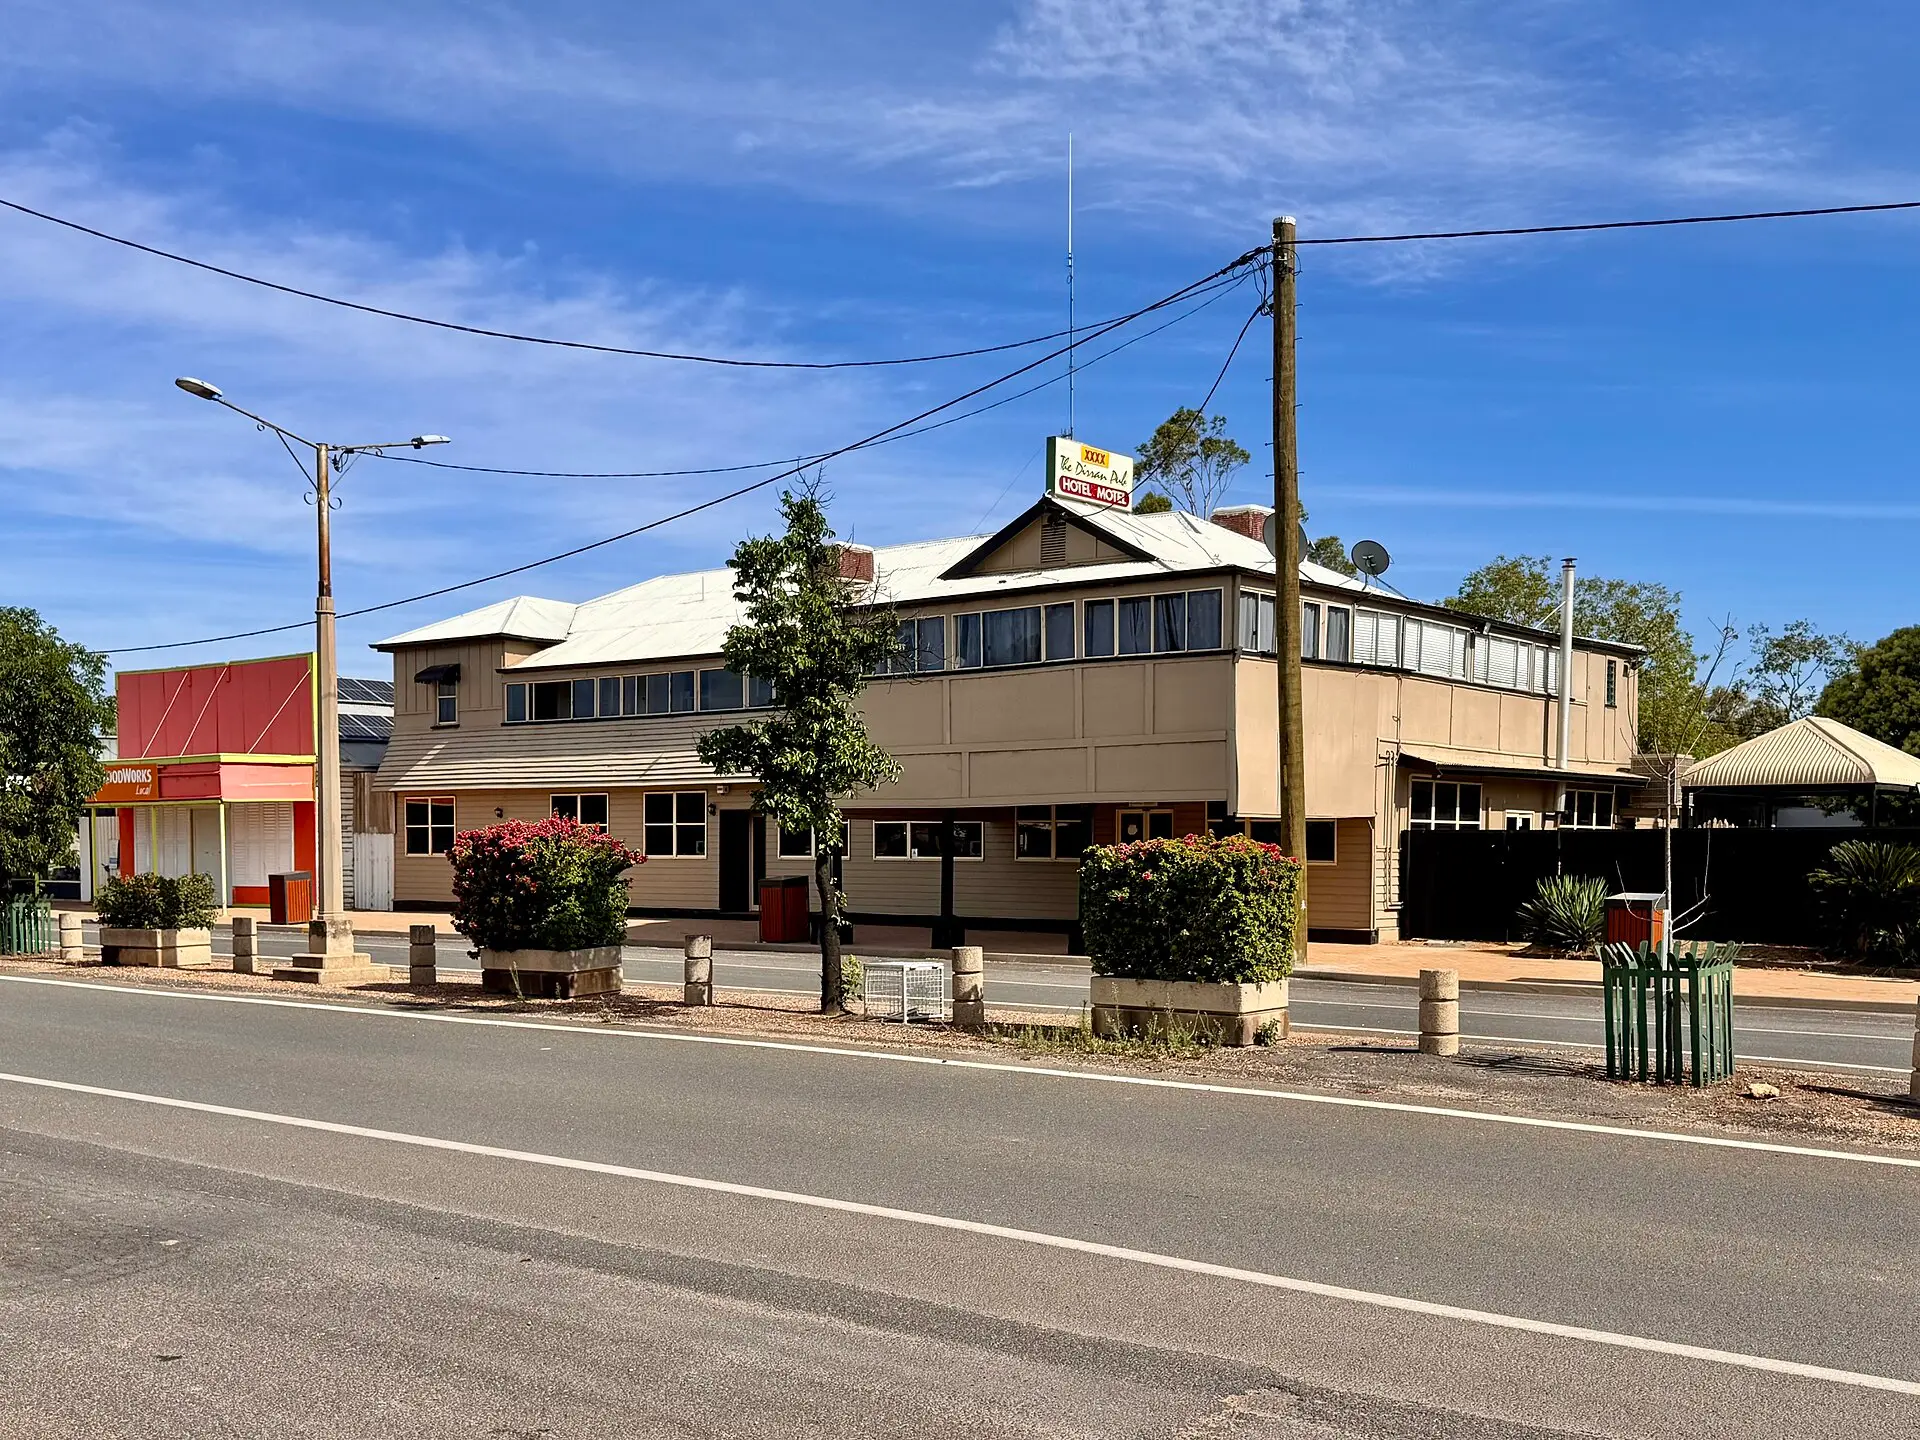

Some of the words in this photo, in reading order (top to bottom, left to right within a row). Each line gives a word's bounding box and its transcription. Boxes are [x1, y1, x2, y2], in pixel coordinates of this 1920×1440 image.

[1060, 455, 1073, 472] The
[1084, 449, 1106, 465] XXXX
[1062, 477, 1093, 497] HOTEL
[1096, 486, 1127, 505] MOTEL
[107, 768, 152, 784] OODWORKS
[135, 784, 152, 796] Local
